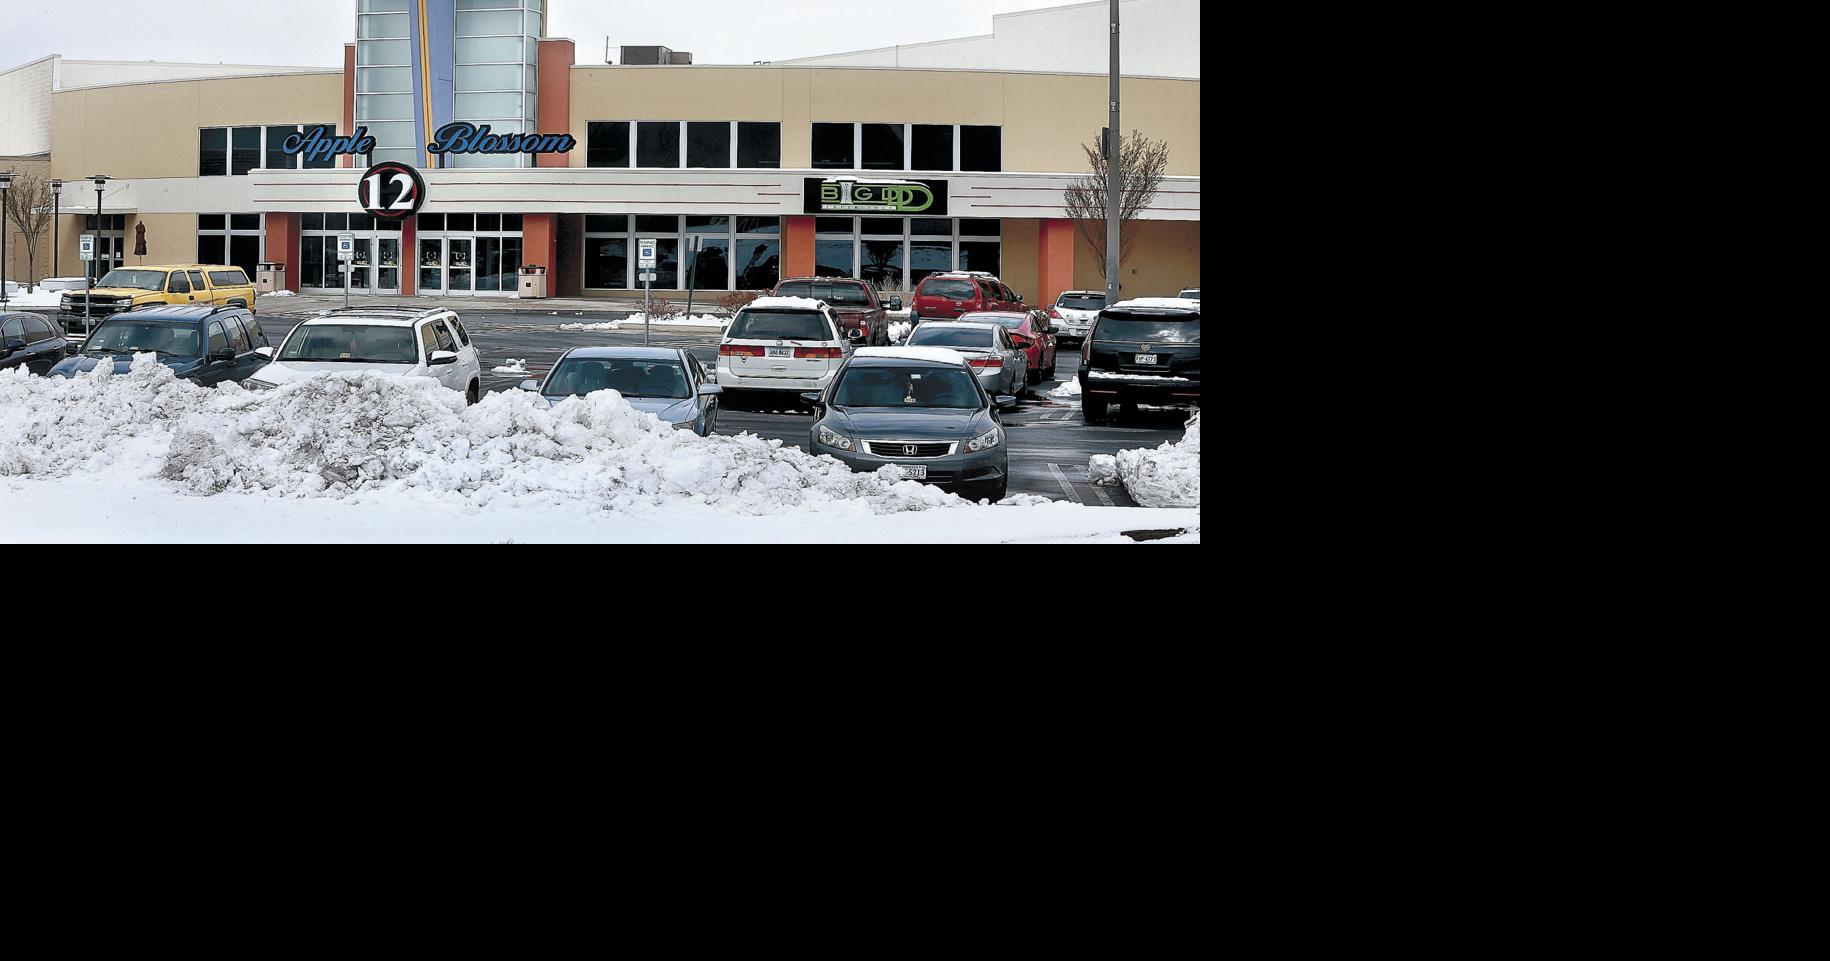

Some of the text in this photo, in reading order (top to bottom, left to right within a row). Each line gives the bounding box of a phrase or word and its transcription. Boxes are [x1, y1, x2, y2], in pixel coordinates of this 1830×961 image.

[282, 122, 576, 162] Apple Blossom
[363, 172, 415, 210] 12
